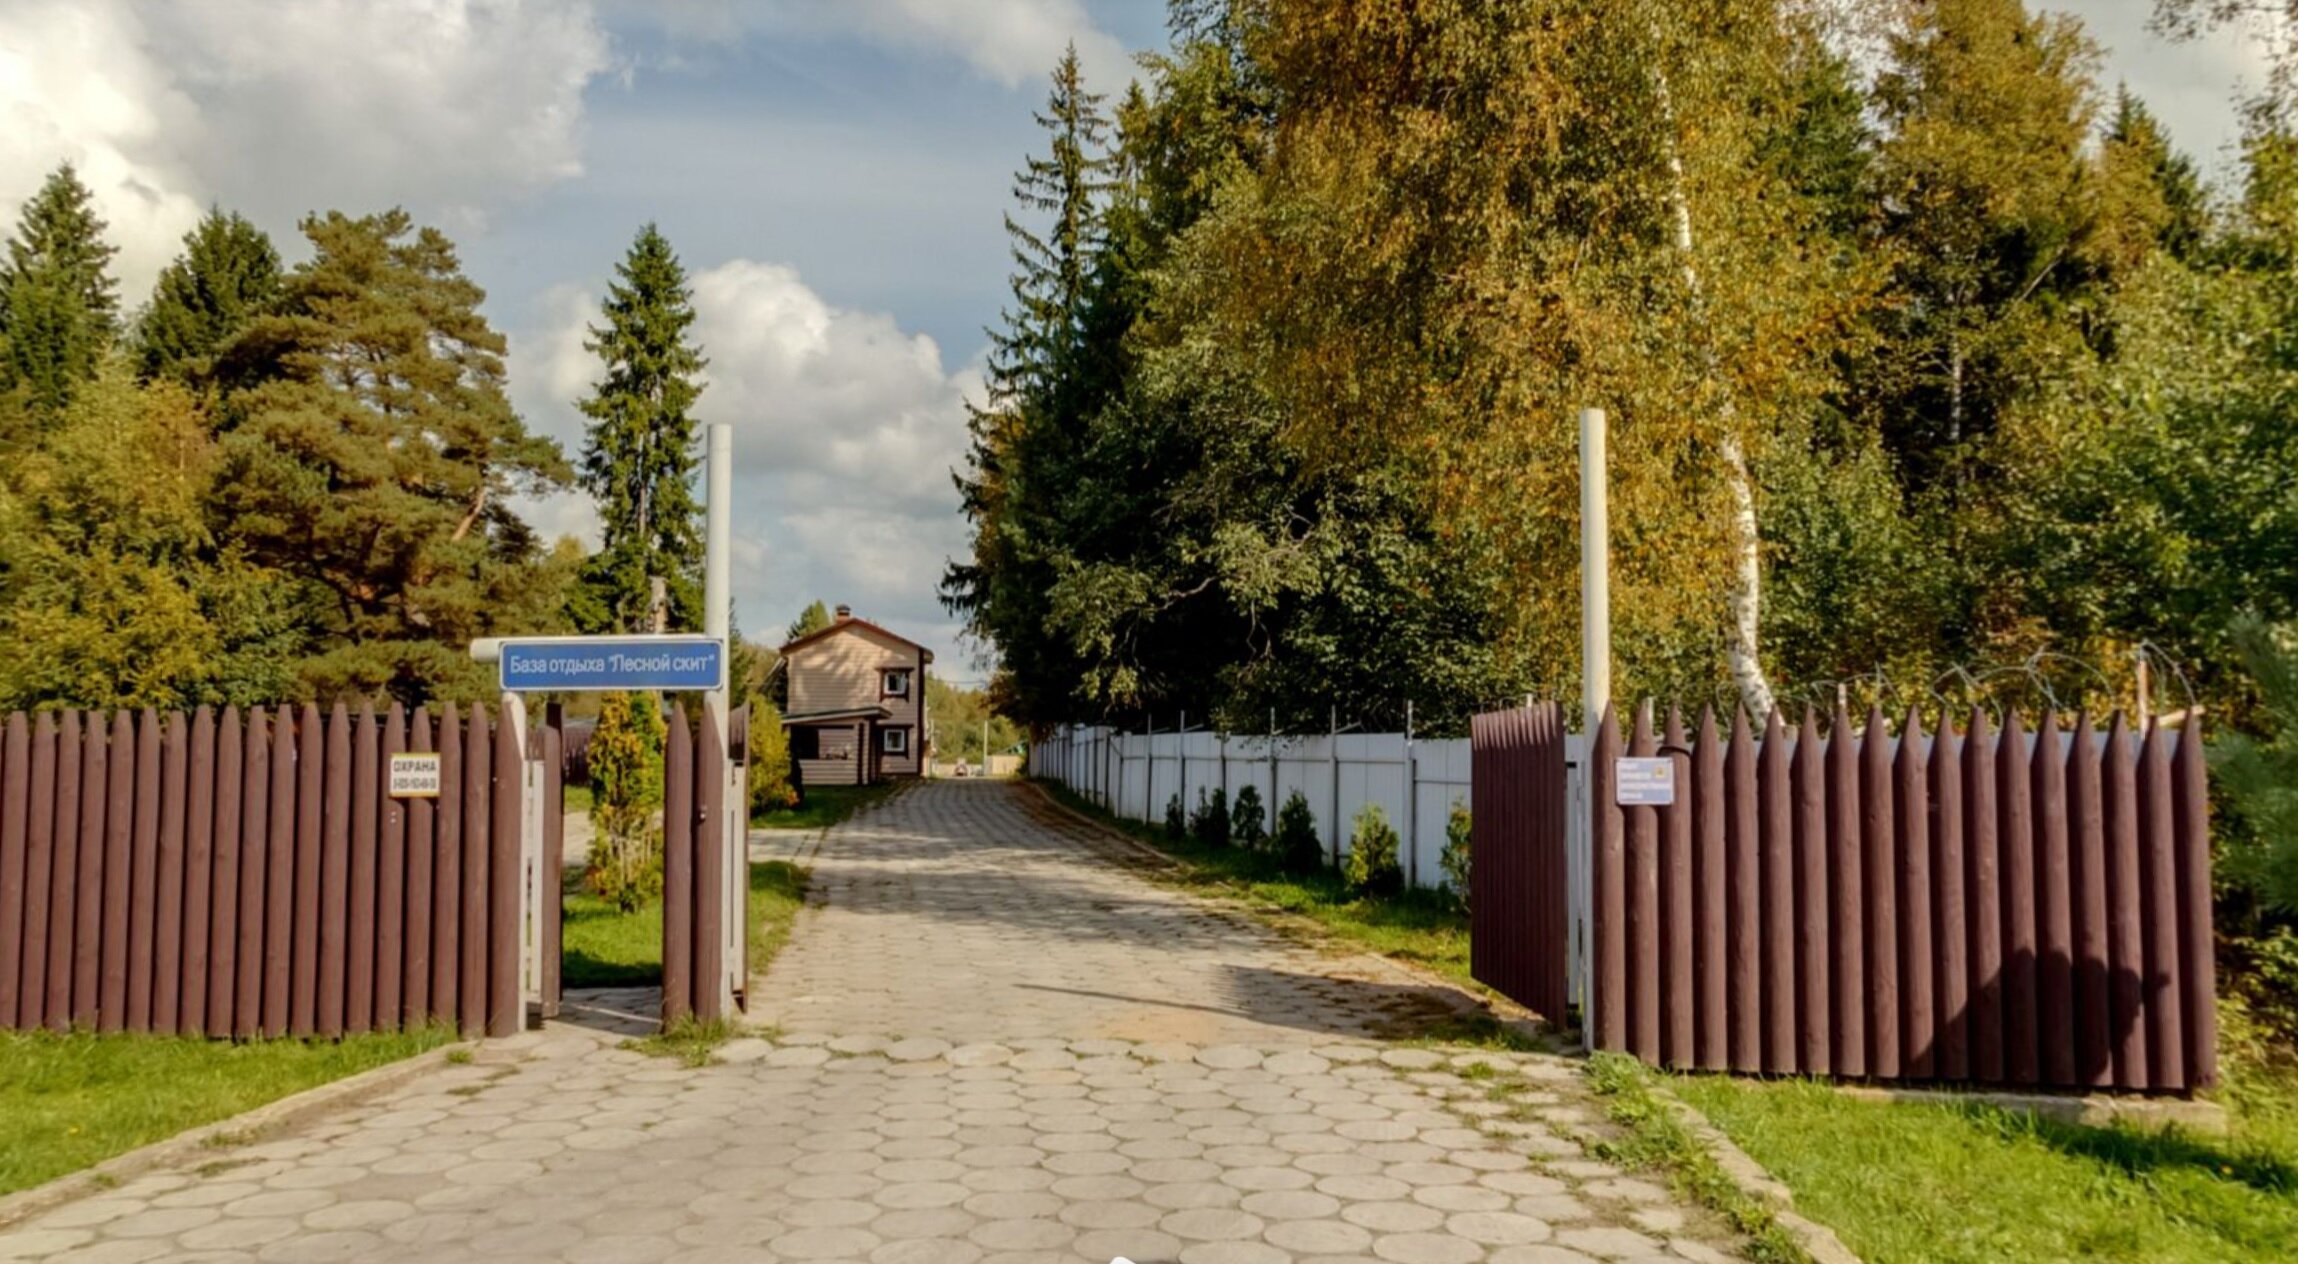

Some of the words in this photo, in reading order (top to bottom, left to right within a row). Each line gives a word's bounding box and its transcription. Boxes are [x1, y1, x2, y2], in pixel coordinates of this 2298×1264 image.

[510, 656, 547, 674] База
[549, 659, 605, 676] отдыха
[608, 654, 670, 673] "Лесной
[672, 653, 715, 672] скит"
[393, 760, 436, 773] ОХРАНА
